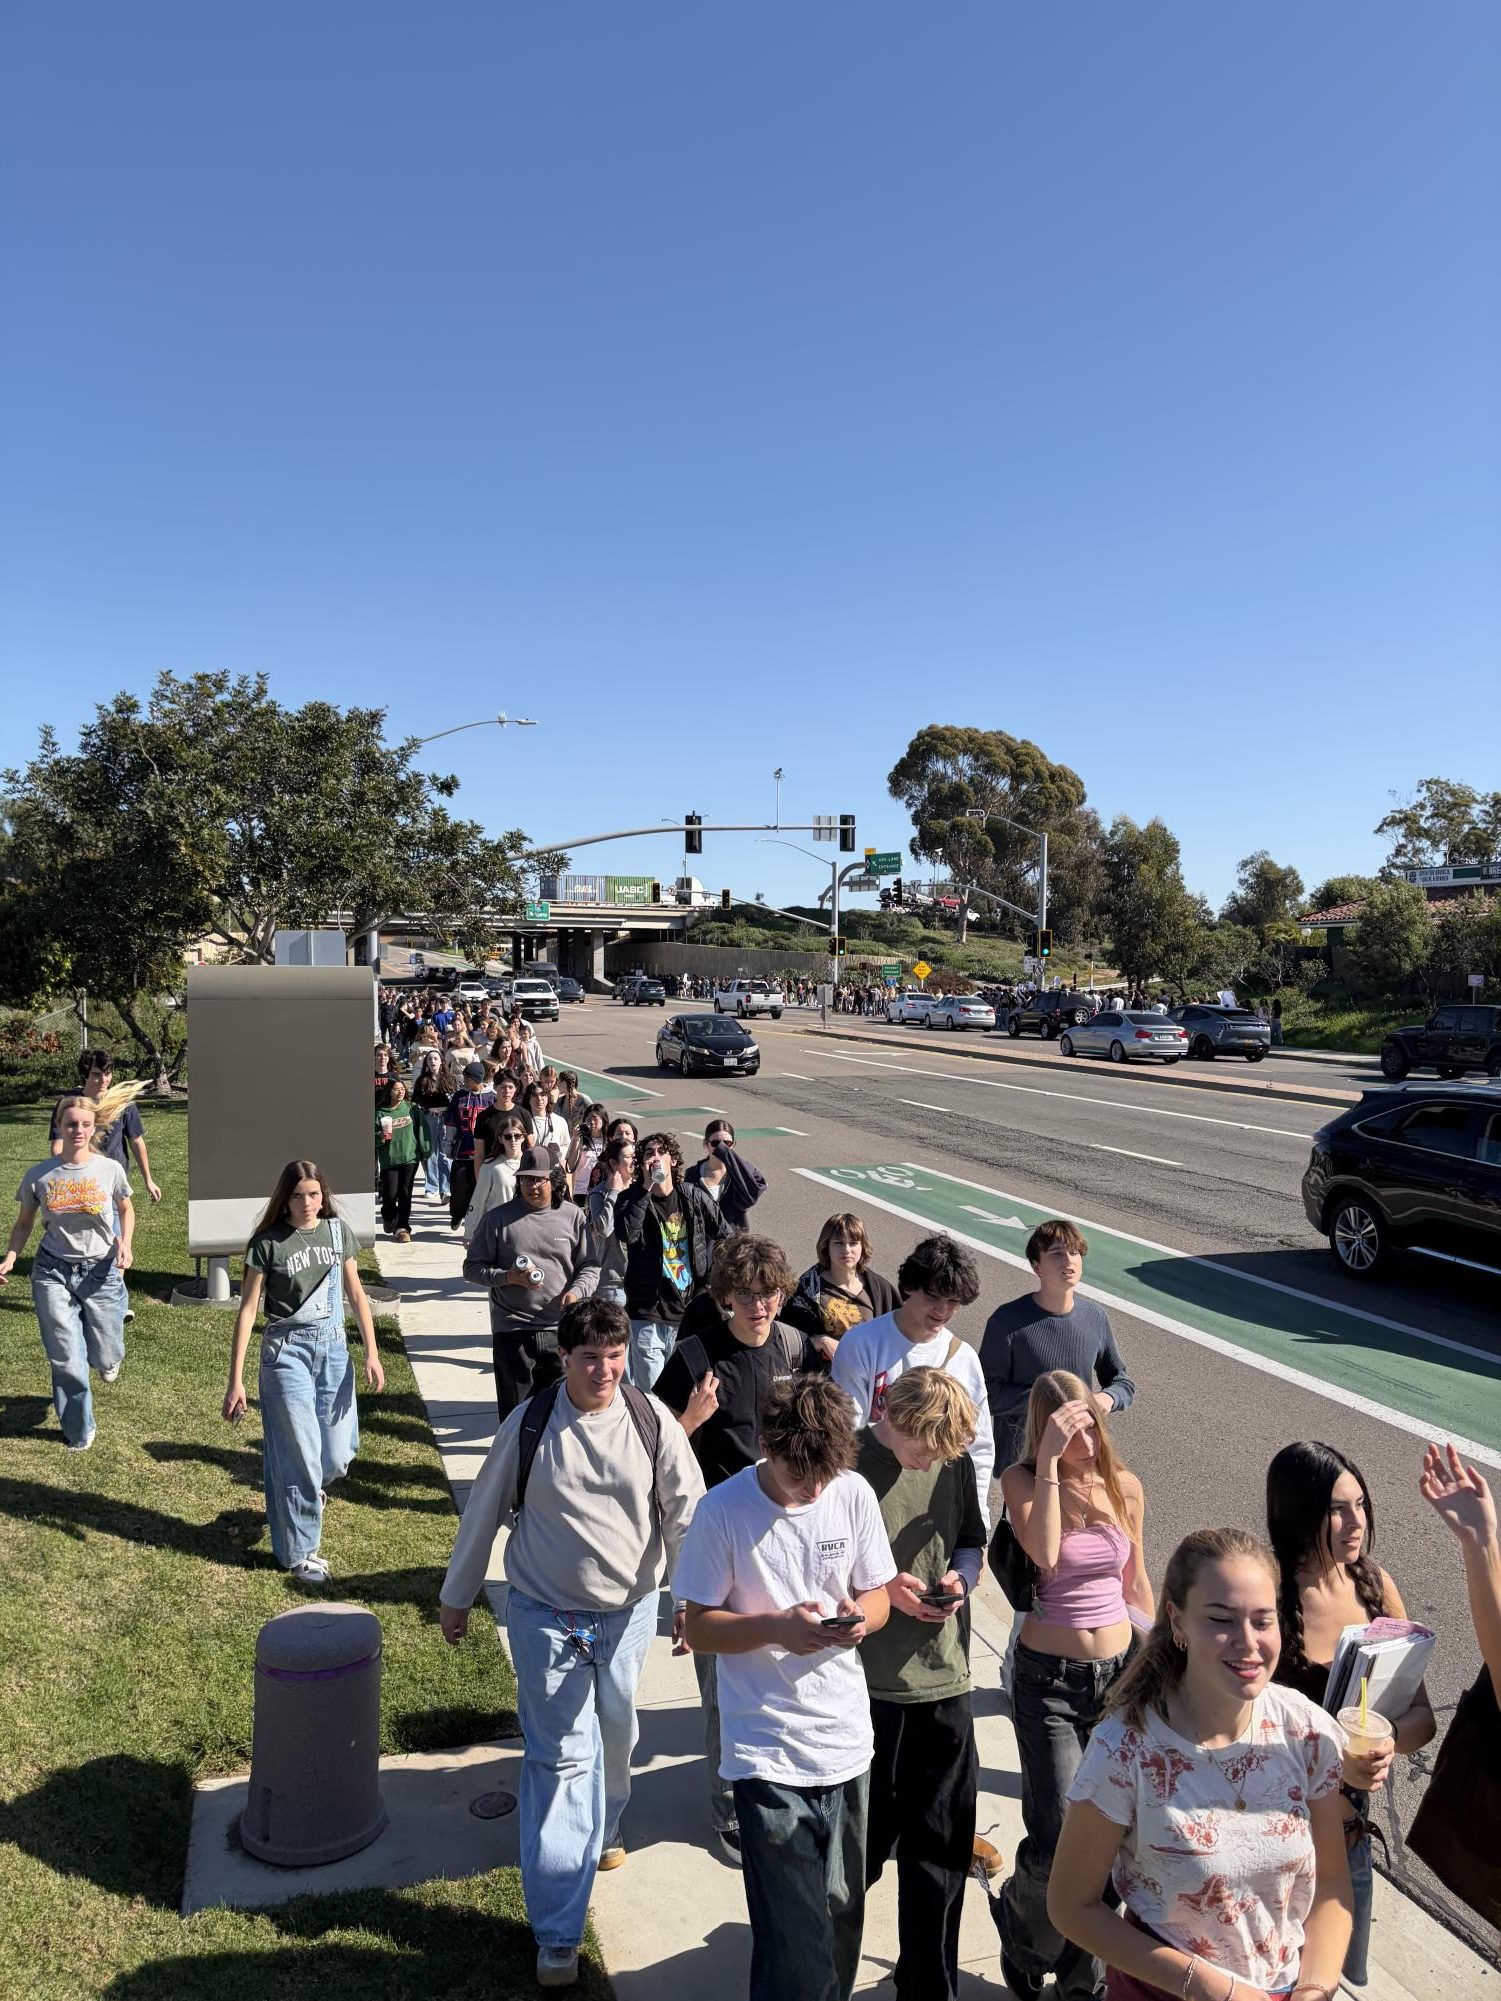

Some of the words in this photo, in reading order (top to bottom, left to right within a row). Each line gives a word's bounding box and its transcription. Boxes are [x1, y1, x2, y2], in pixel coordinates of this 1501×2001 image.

[615, 885, 644, 894] UASC
[286, 1247, 311, 1278] NEW
[821, 1541, 845, 1551] RVCA
